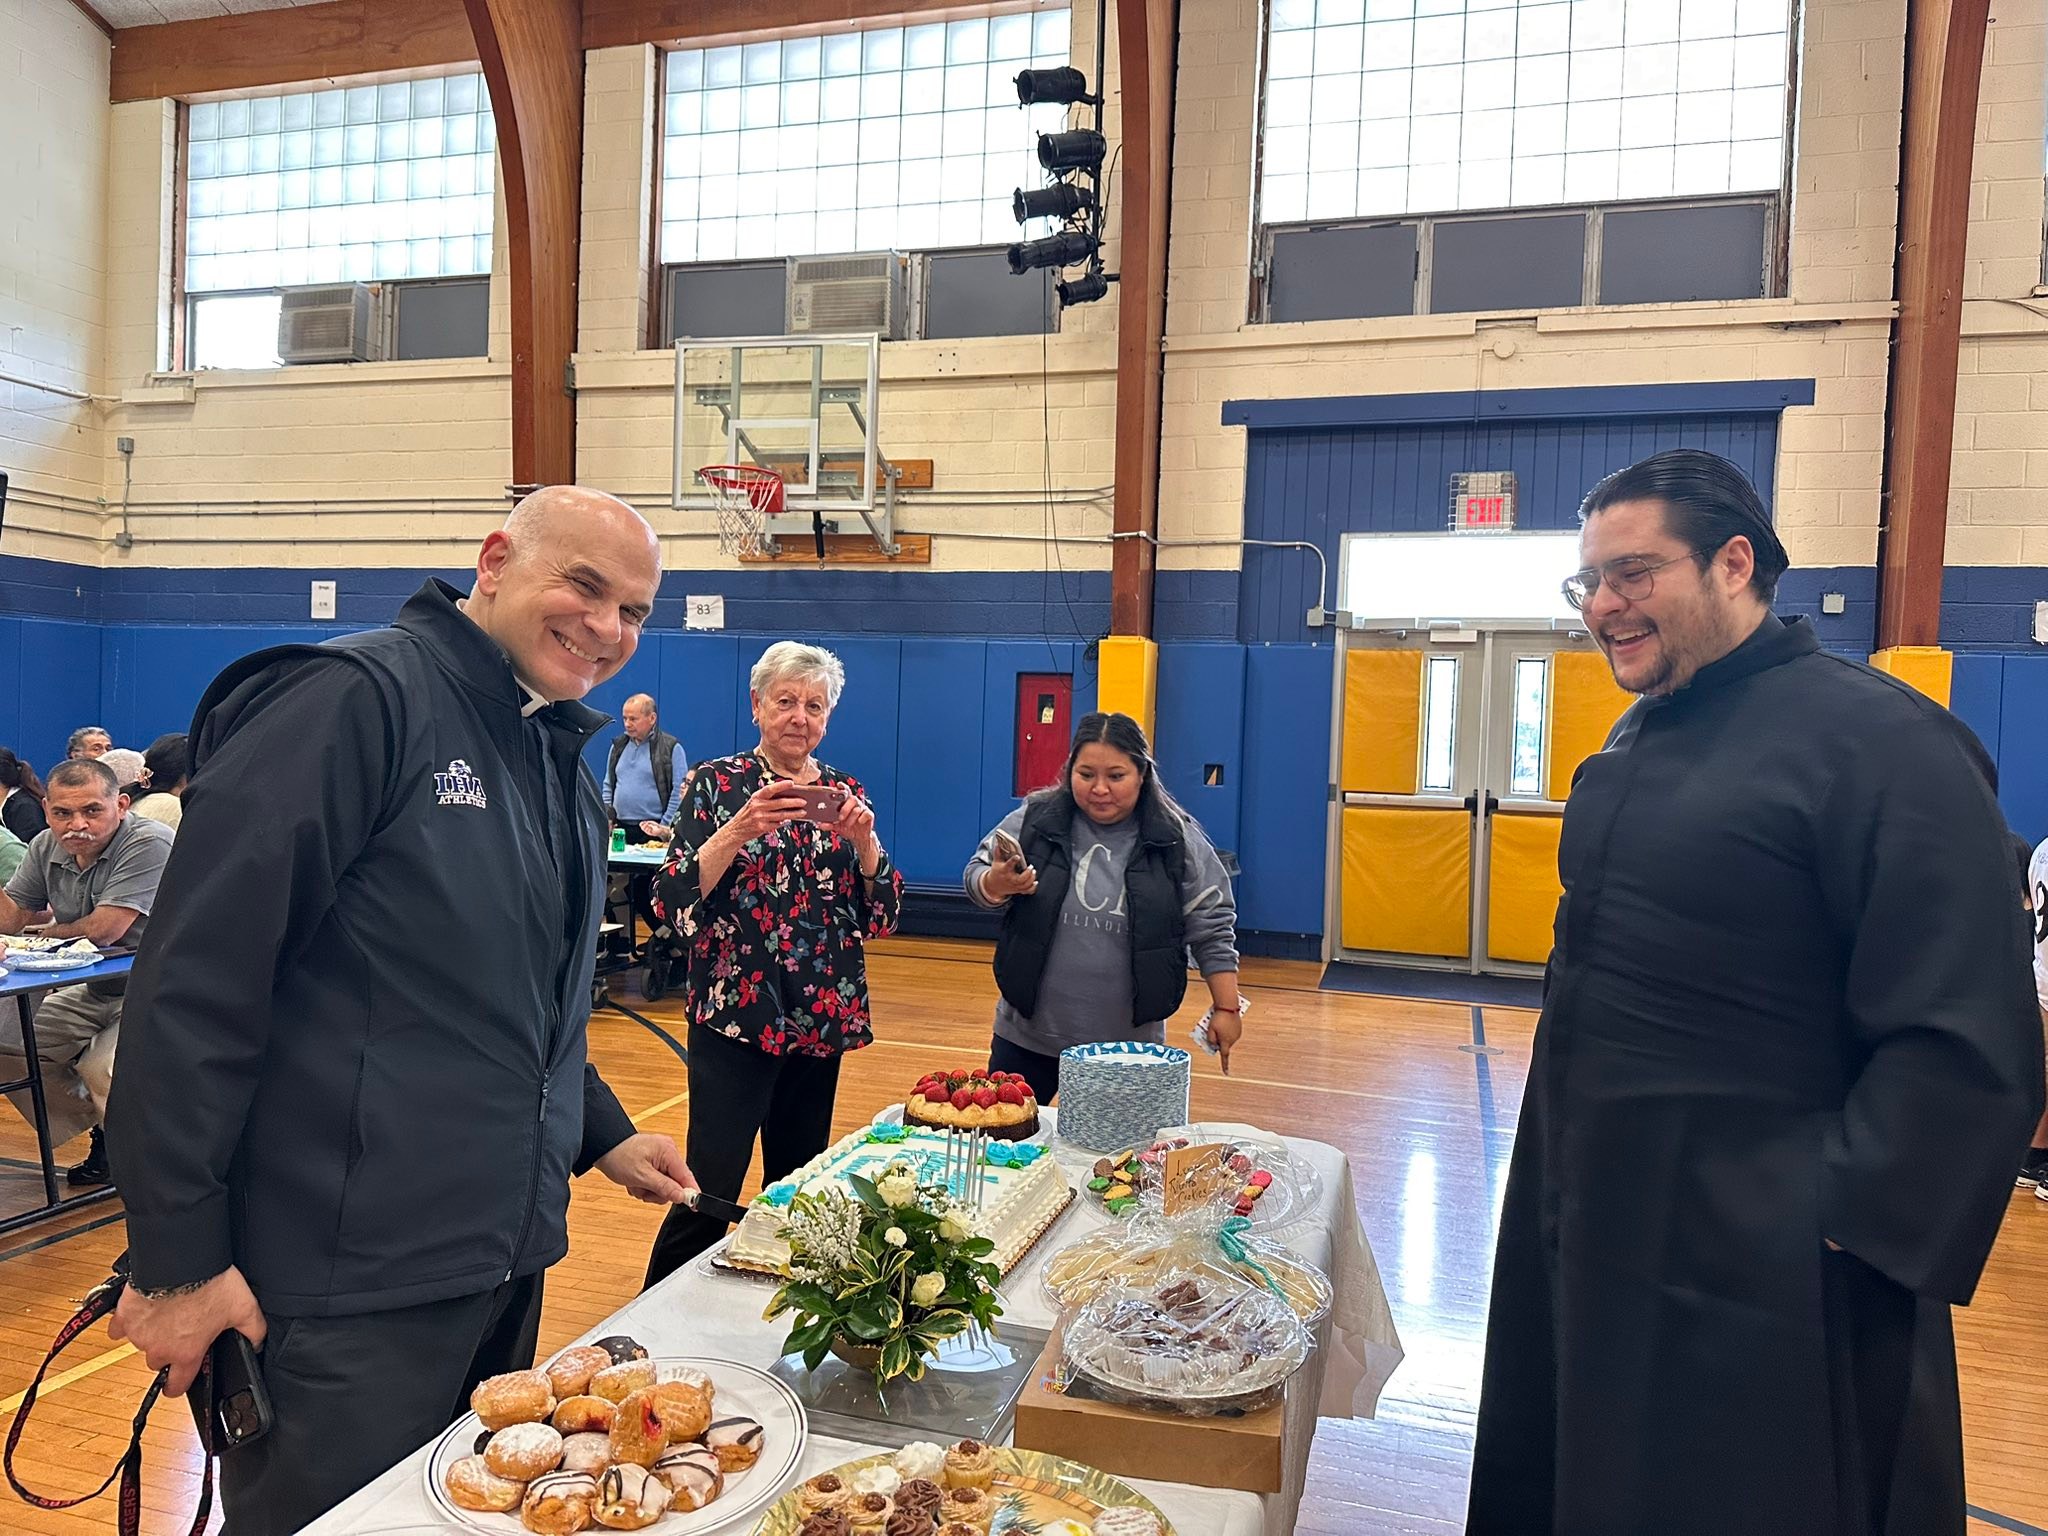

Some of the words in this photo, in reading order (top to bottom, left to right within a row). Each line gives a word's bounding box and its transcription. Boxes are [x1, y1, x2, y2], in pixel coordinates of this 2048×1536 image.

[1466, 497, 1504, 526] EXIT
[697, 604, 710, 615] 83
[434, 772, 487, 801] IHA
[437, 795, 486, 809] ATHLETICS
